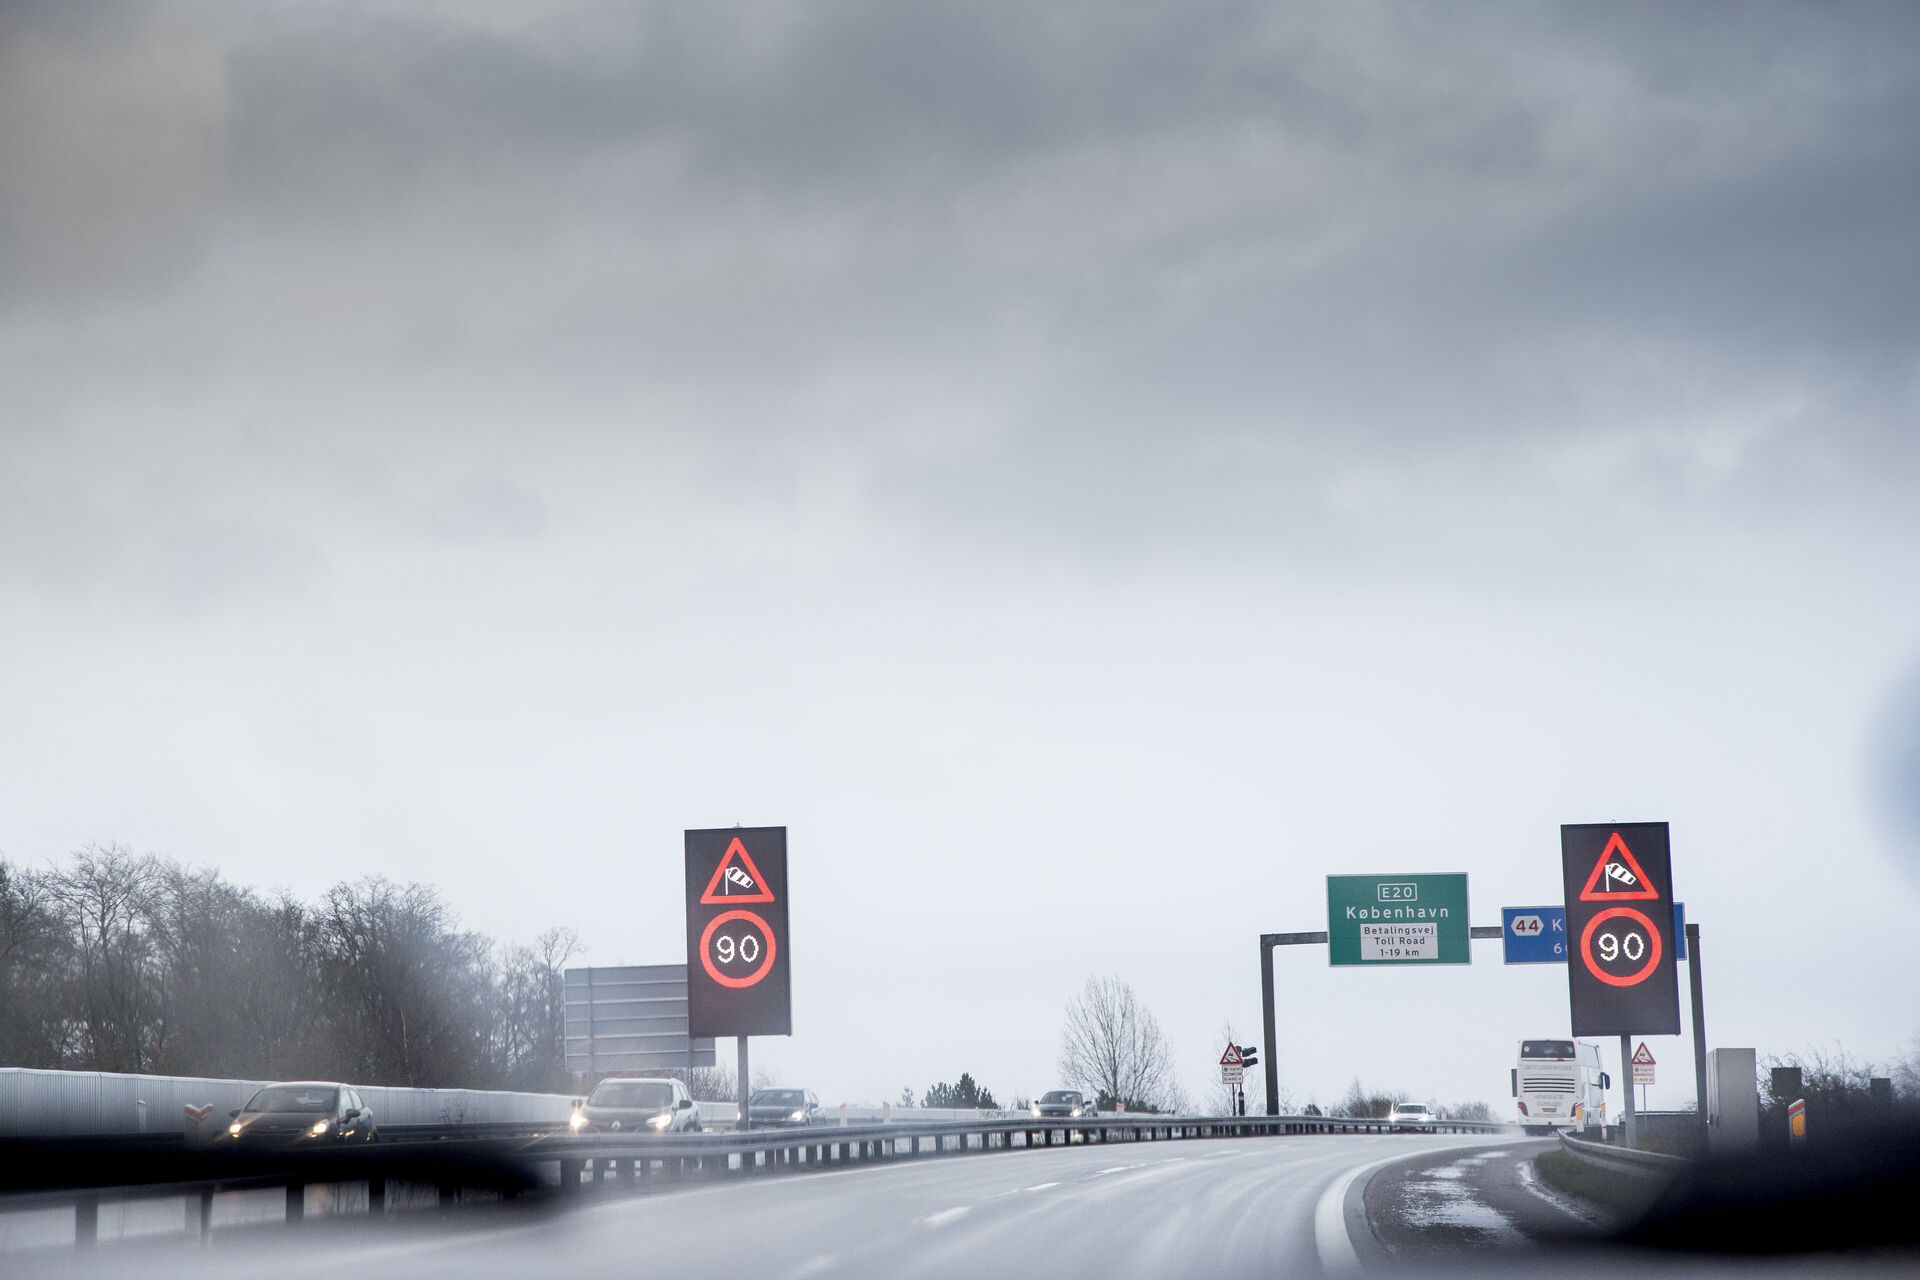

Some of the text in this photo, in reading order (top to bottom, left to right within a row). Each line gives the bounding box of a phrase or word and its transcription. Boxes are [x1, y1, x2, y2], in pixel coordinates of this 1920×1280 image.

[1382, 887, 1413, 898] E20
[1346, 906, 1449, 919] København
[1364, 926, 1434, 935] Betalingsvej
[1516, 919, 1539, 932] 44
[1375, 937, 1425, 945] Toll Road
[1598, 933, 1644, 961] 90
[717, 935, 759, 963] 90
[1380, 948, 1420, 957] 1-19 km
